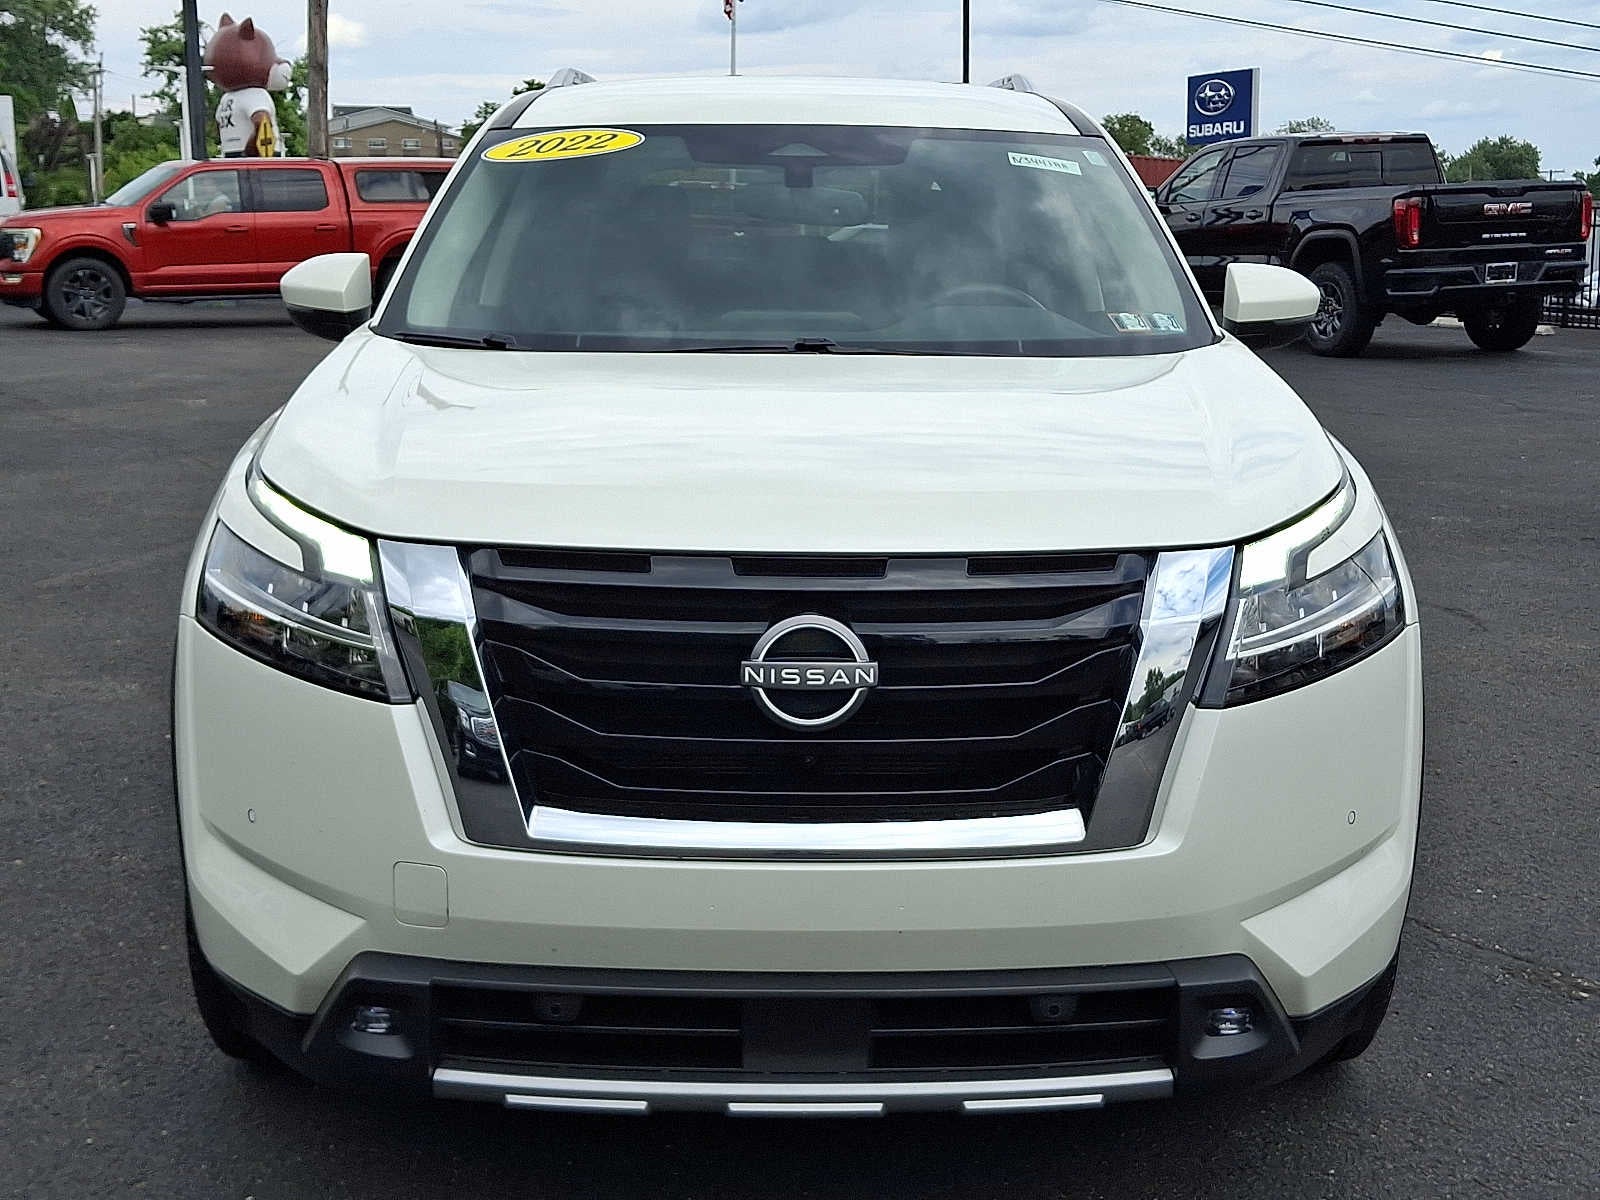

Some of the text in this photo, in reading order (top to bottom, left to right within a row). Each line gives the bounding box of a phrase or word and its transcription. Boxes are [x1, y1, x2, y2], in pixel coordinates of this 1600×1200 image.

[1188, 120, 1245, 138] SUBARU
[506, 133, 618, 158] 2022
[1483, 202, 1533, 216] GMC
[743, 666, 875, 686] NISSAN
